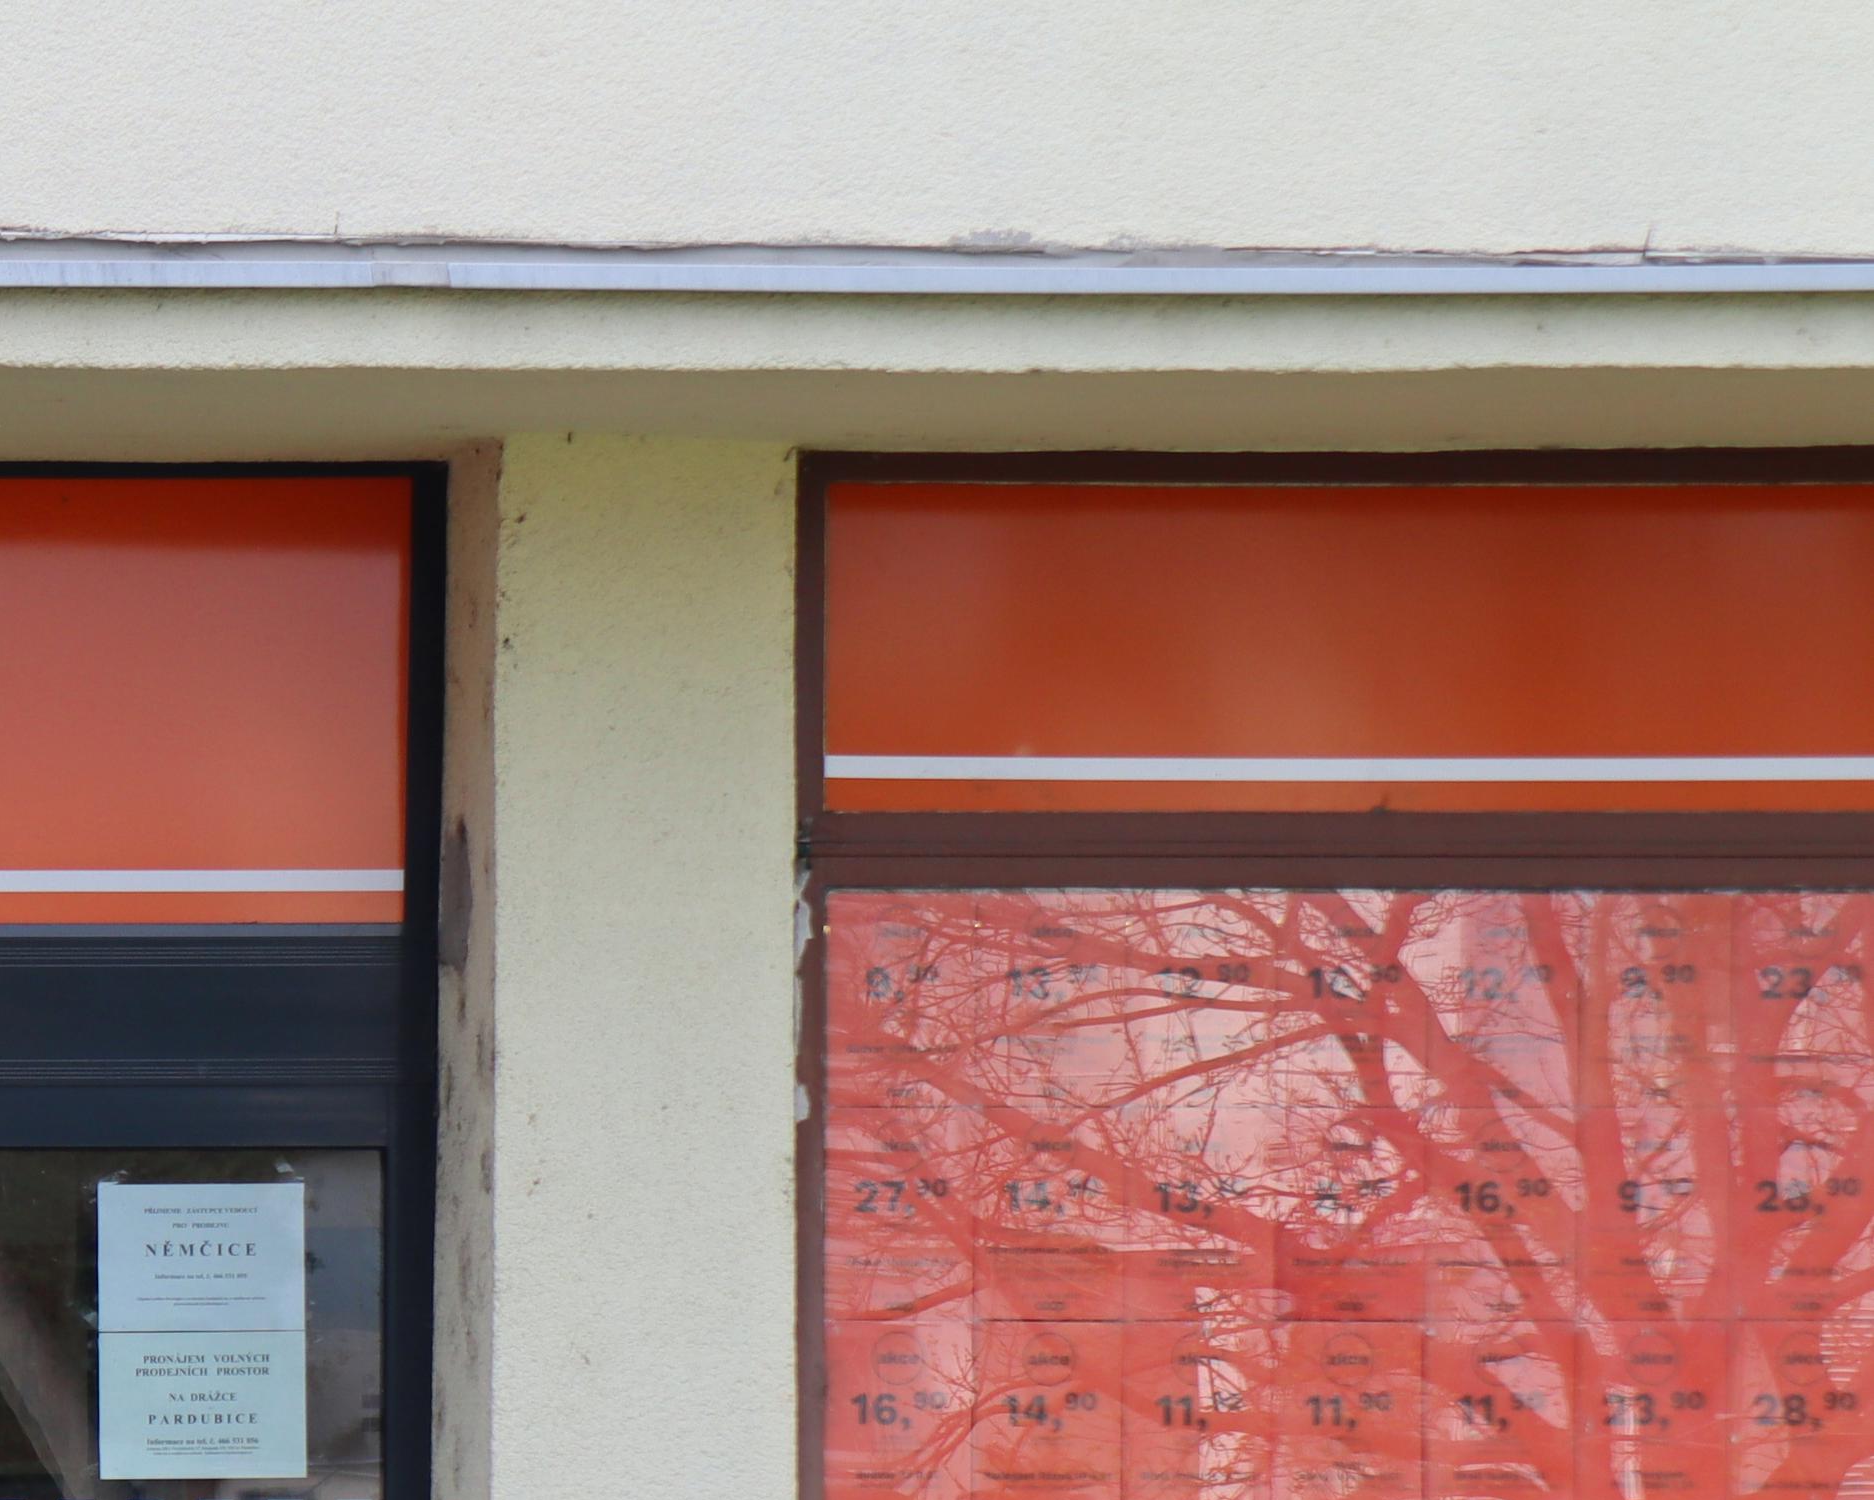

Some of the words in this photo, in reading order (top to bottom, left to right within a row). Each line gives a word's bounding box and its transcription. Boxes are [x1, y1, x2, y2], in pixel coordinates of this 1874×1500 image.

[145, 1240, 257, 1257] NĚMČICE
[143, 1354, 205, 1364] PRONÁJEM
[213, 1353, 270, 1363] VOLNÝCH
[135, 1367, 208, 1377] PRODEJNÍCH
[216, 1366, 270, 1376] PROSTOR
[168, 1393, 185, 1402] NA
[190, 1392, 236, 1402] DRÁŽCE
[148, 1413, 258, 1425] PARDUBICE
